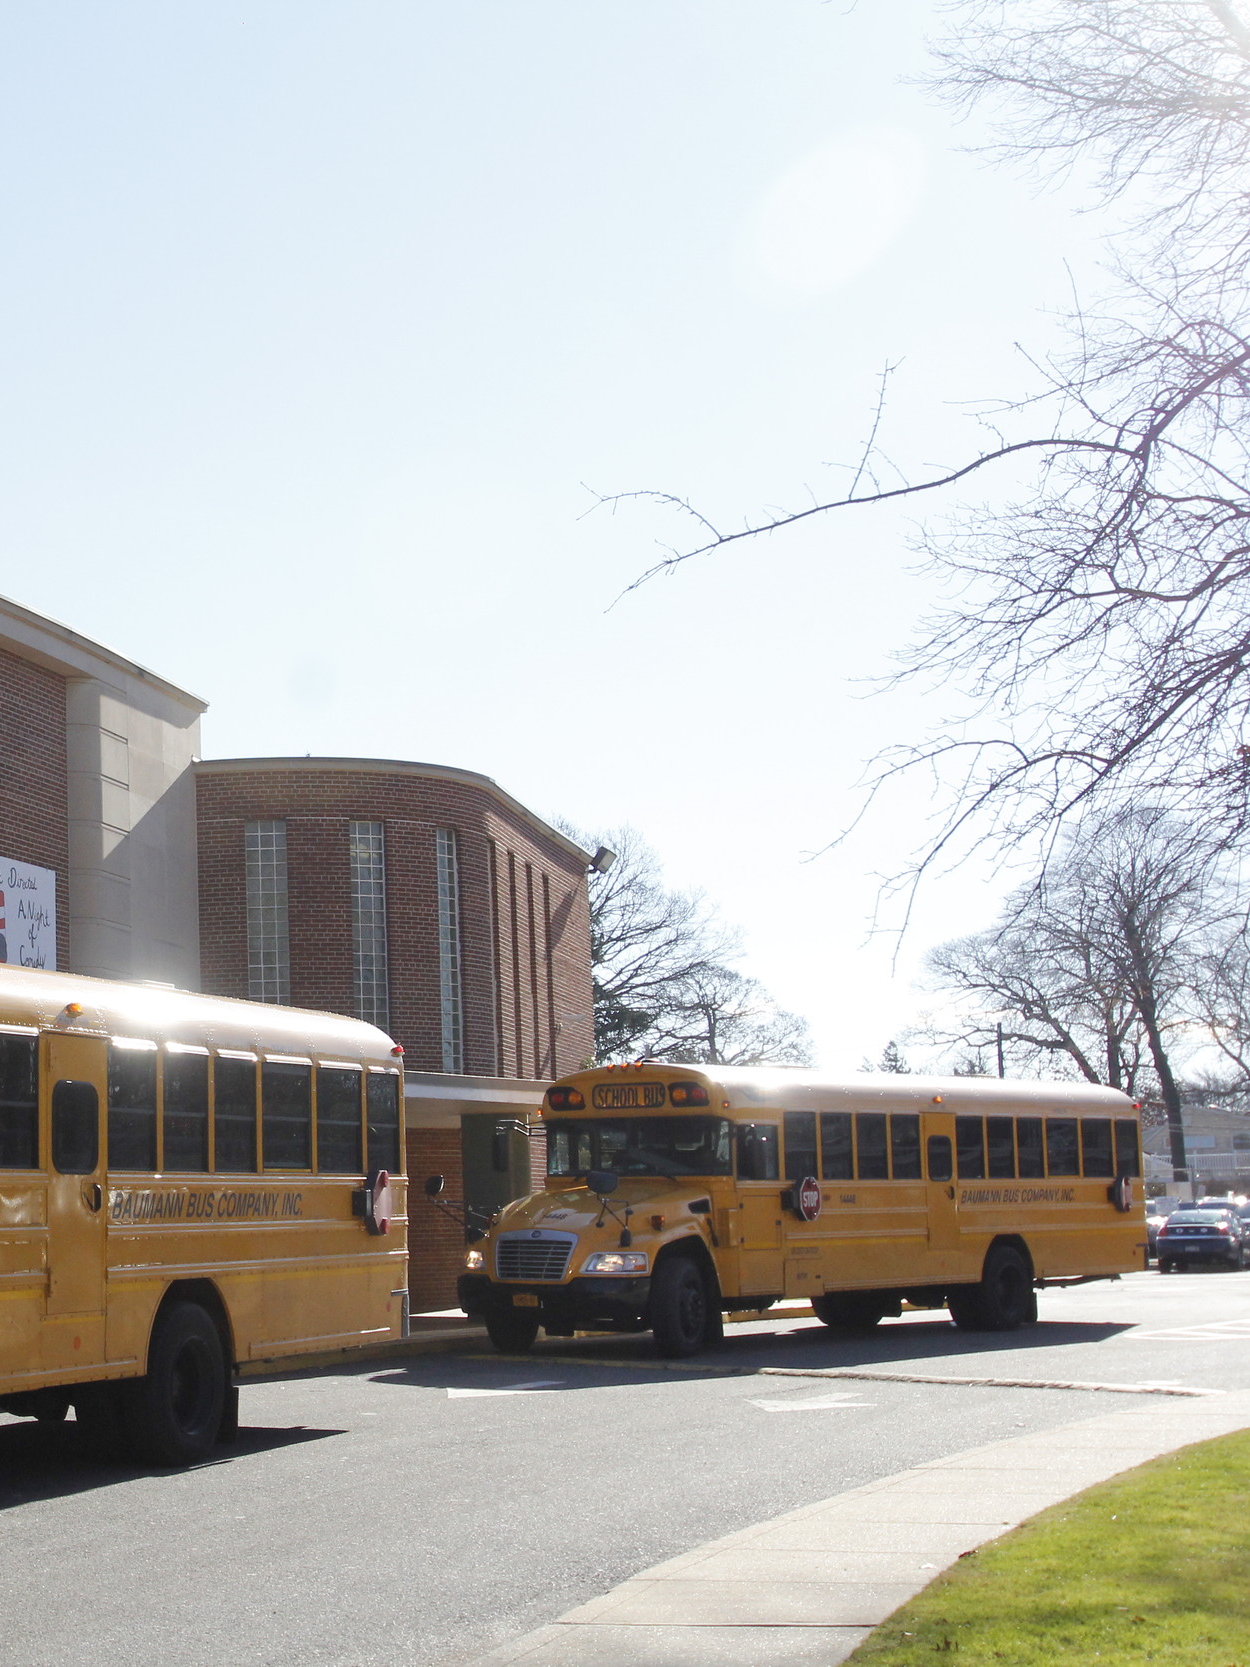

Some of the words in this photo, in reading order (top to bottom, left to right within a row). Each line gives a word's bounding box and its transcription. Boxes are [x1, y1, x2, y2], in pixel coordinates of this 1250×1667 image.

[8, 867, 38, 890] Directed
[18, 899, 26, 919] A
[28, 900, 50, 931] Night
[28, 923, 38, 948] of
[598, 1087, 639, 1106] SCHOOL
[644, 1086, 665, 1105] BUS
[112, 1192, 185, 1219] BAUMANN
[186, 1192, 215, 1218] BUS
[217, 1192, 280, 1217] COMPANY,
[281, 1193, 303, 1217] INC.
[803, 1191, 818, 1207] STOP
[961, 1189, 1002, 1204] BAUMANN
[1003, 1189, 1020, 1203] BUS
